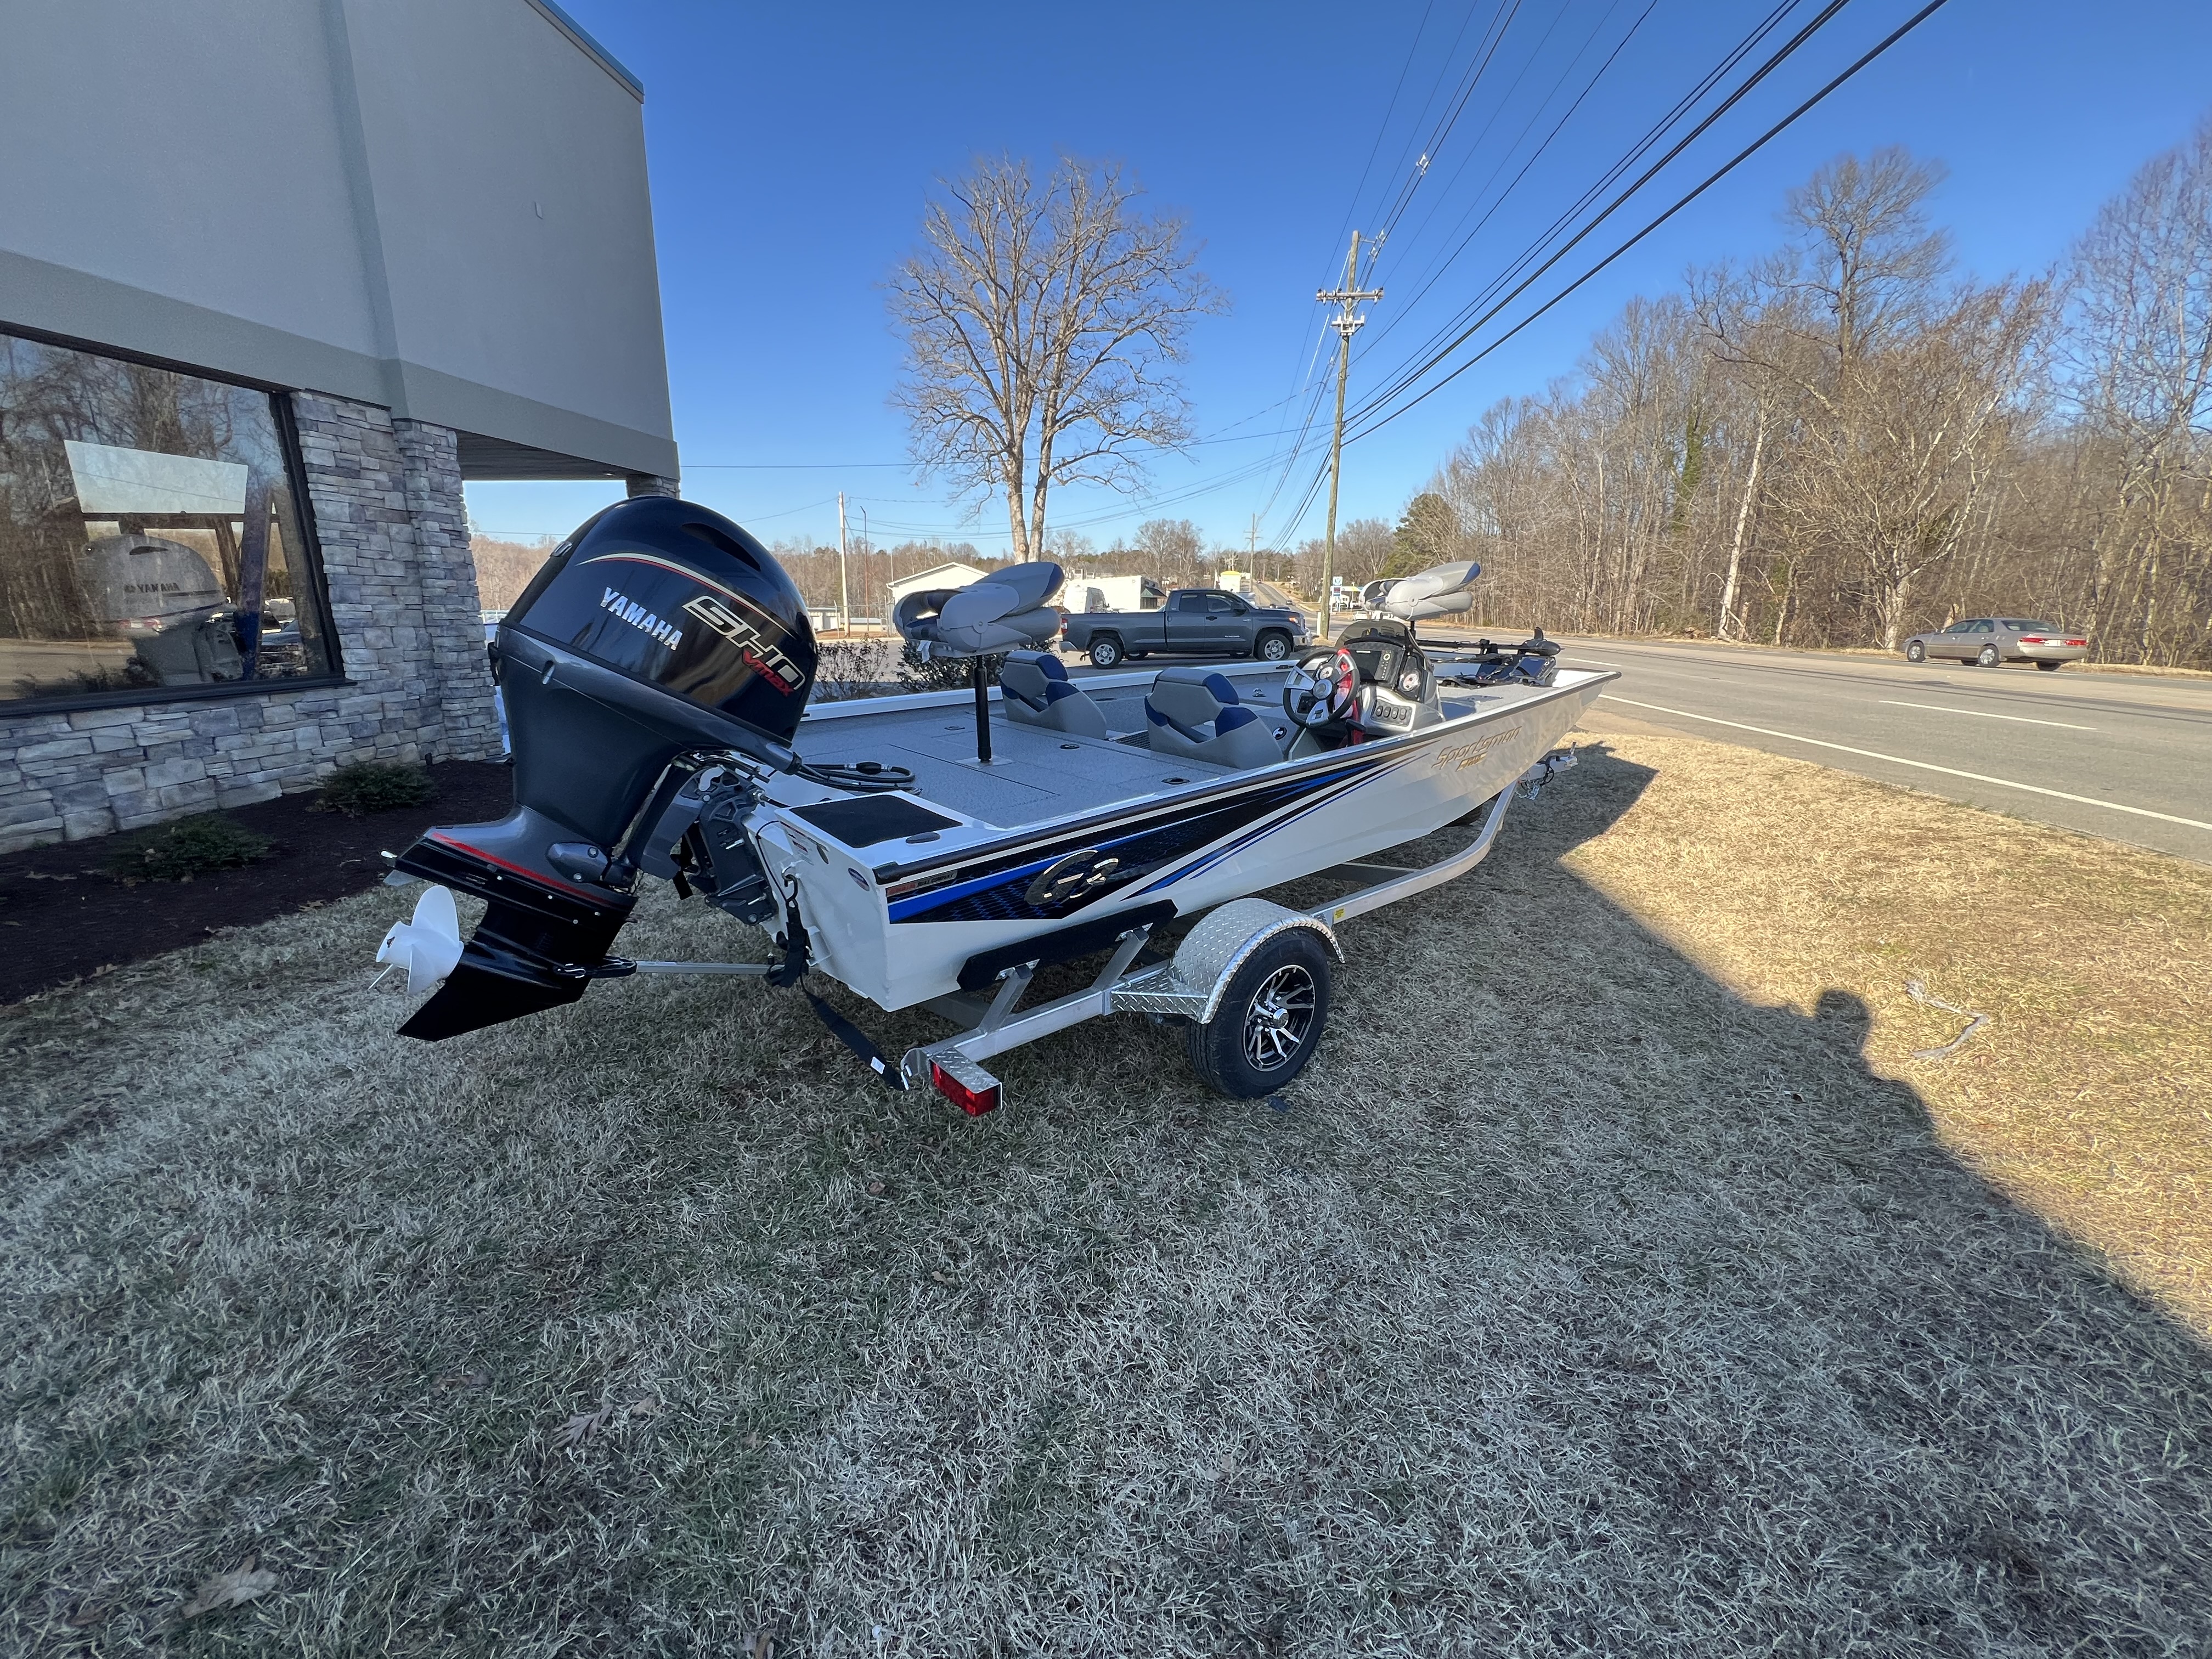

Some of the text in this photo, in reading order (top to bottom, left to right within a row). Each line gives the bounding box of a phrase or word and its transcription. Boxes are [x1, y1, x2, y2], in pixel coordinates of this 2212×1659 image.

[600, 586, 683, 651] YAMAHA
[681, 595, 806, 690] SHO
[1431, 726, 1523, 770] Sportsman
[1024, 849, 1120, 906] G3
